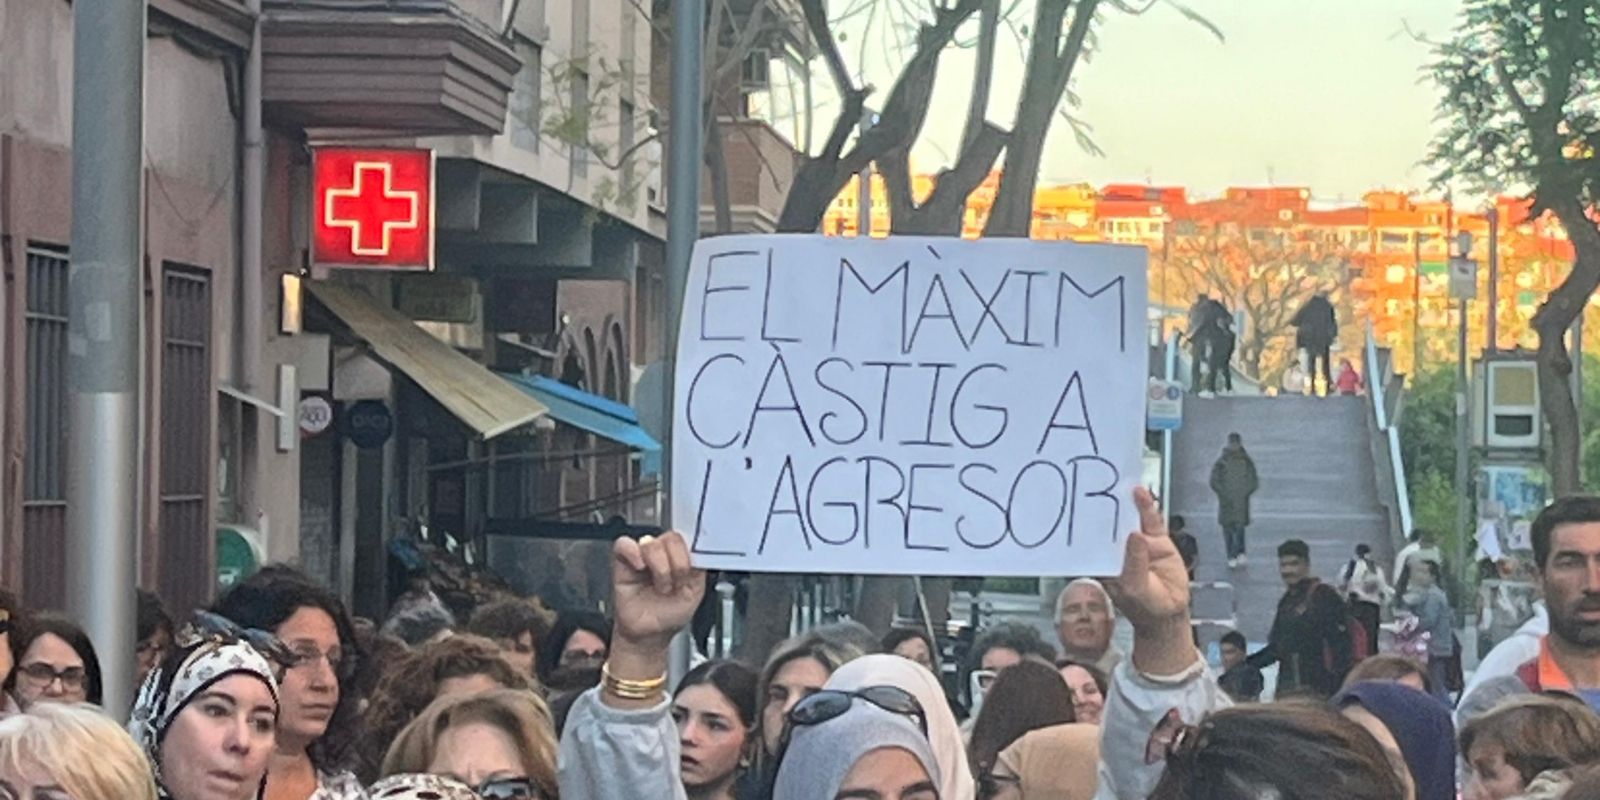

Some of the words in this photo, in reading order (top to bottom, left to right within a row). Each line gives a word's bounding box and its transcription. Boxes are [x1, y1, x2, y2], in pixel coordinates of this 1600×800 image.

[701, 248, 801, 342] EL
[832, 245, 1125, 354] MÀXIM
[686, 341, 1009, 449] CÀSTIG
[1036, 370, 1099, 455] A
[690, 454, 1120, 557] L'AGRESOR
